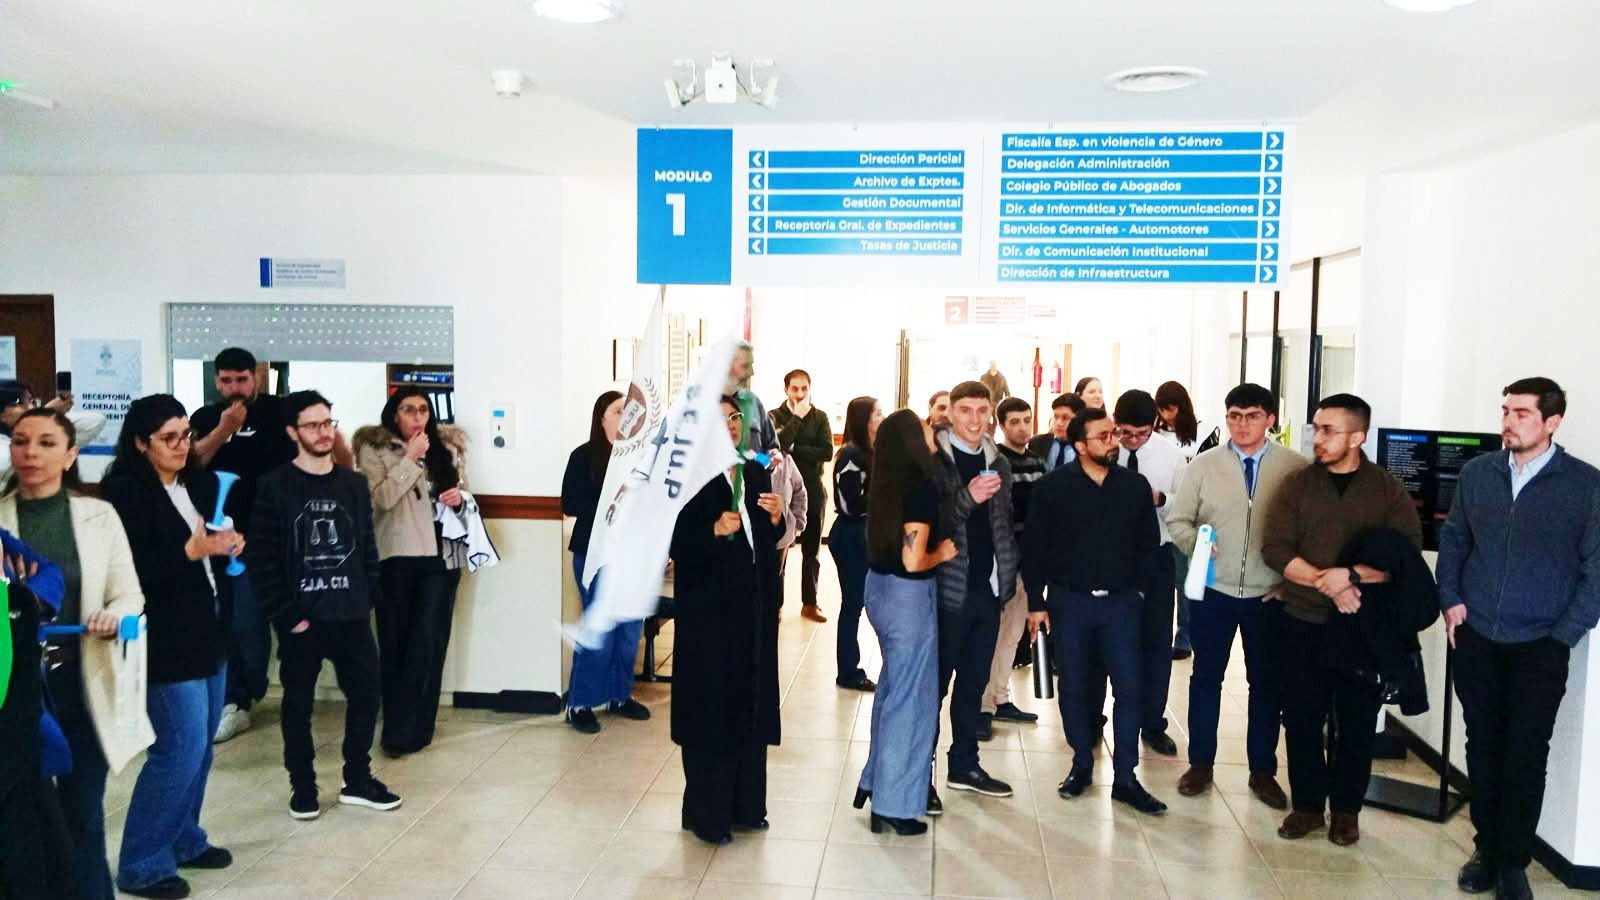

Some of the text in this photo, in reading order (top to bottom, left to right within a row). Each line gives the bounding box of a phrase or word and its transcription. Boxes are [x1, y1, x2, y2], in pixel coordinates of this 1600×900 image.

[1007, 135, 1223, 149] Fiscalía Esp. en violencia de Género
[859, 152, 962, 165] Dirección Pericial
[1007, 157, 1171, 171] Delegación Administración
[654, 169, 713, 183] MODULO
[853, 175, 961, 190] Archivo de Exptes.
[1005, 179, 1182, 194] Colegio Público de Abogados
[842, 196, 962, 209] Gestión Documental
[1005, 202, 1255, 217] Dir. de Informática y Telecomunicaciones
[665, 193, 686, 236] 1
[775, 219, 957, 233] Receptoría Gral. de Expedientes
[1003, 223, 1057, 235] Servicios
[1059, 223, 1119, 235] Generales
[1129, 223, 1209, 235] Automotores
[860, 240, 957, 251] Tasas de Justicia
[1001, 245, 1209, 257] Dir. de Comunicación Institucional
[1001, 266, 1170, 279] Dirección de Infraestructura
